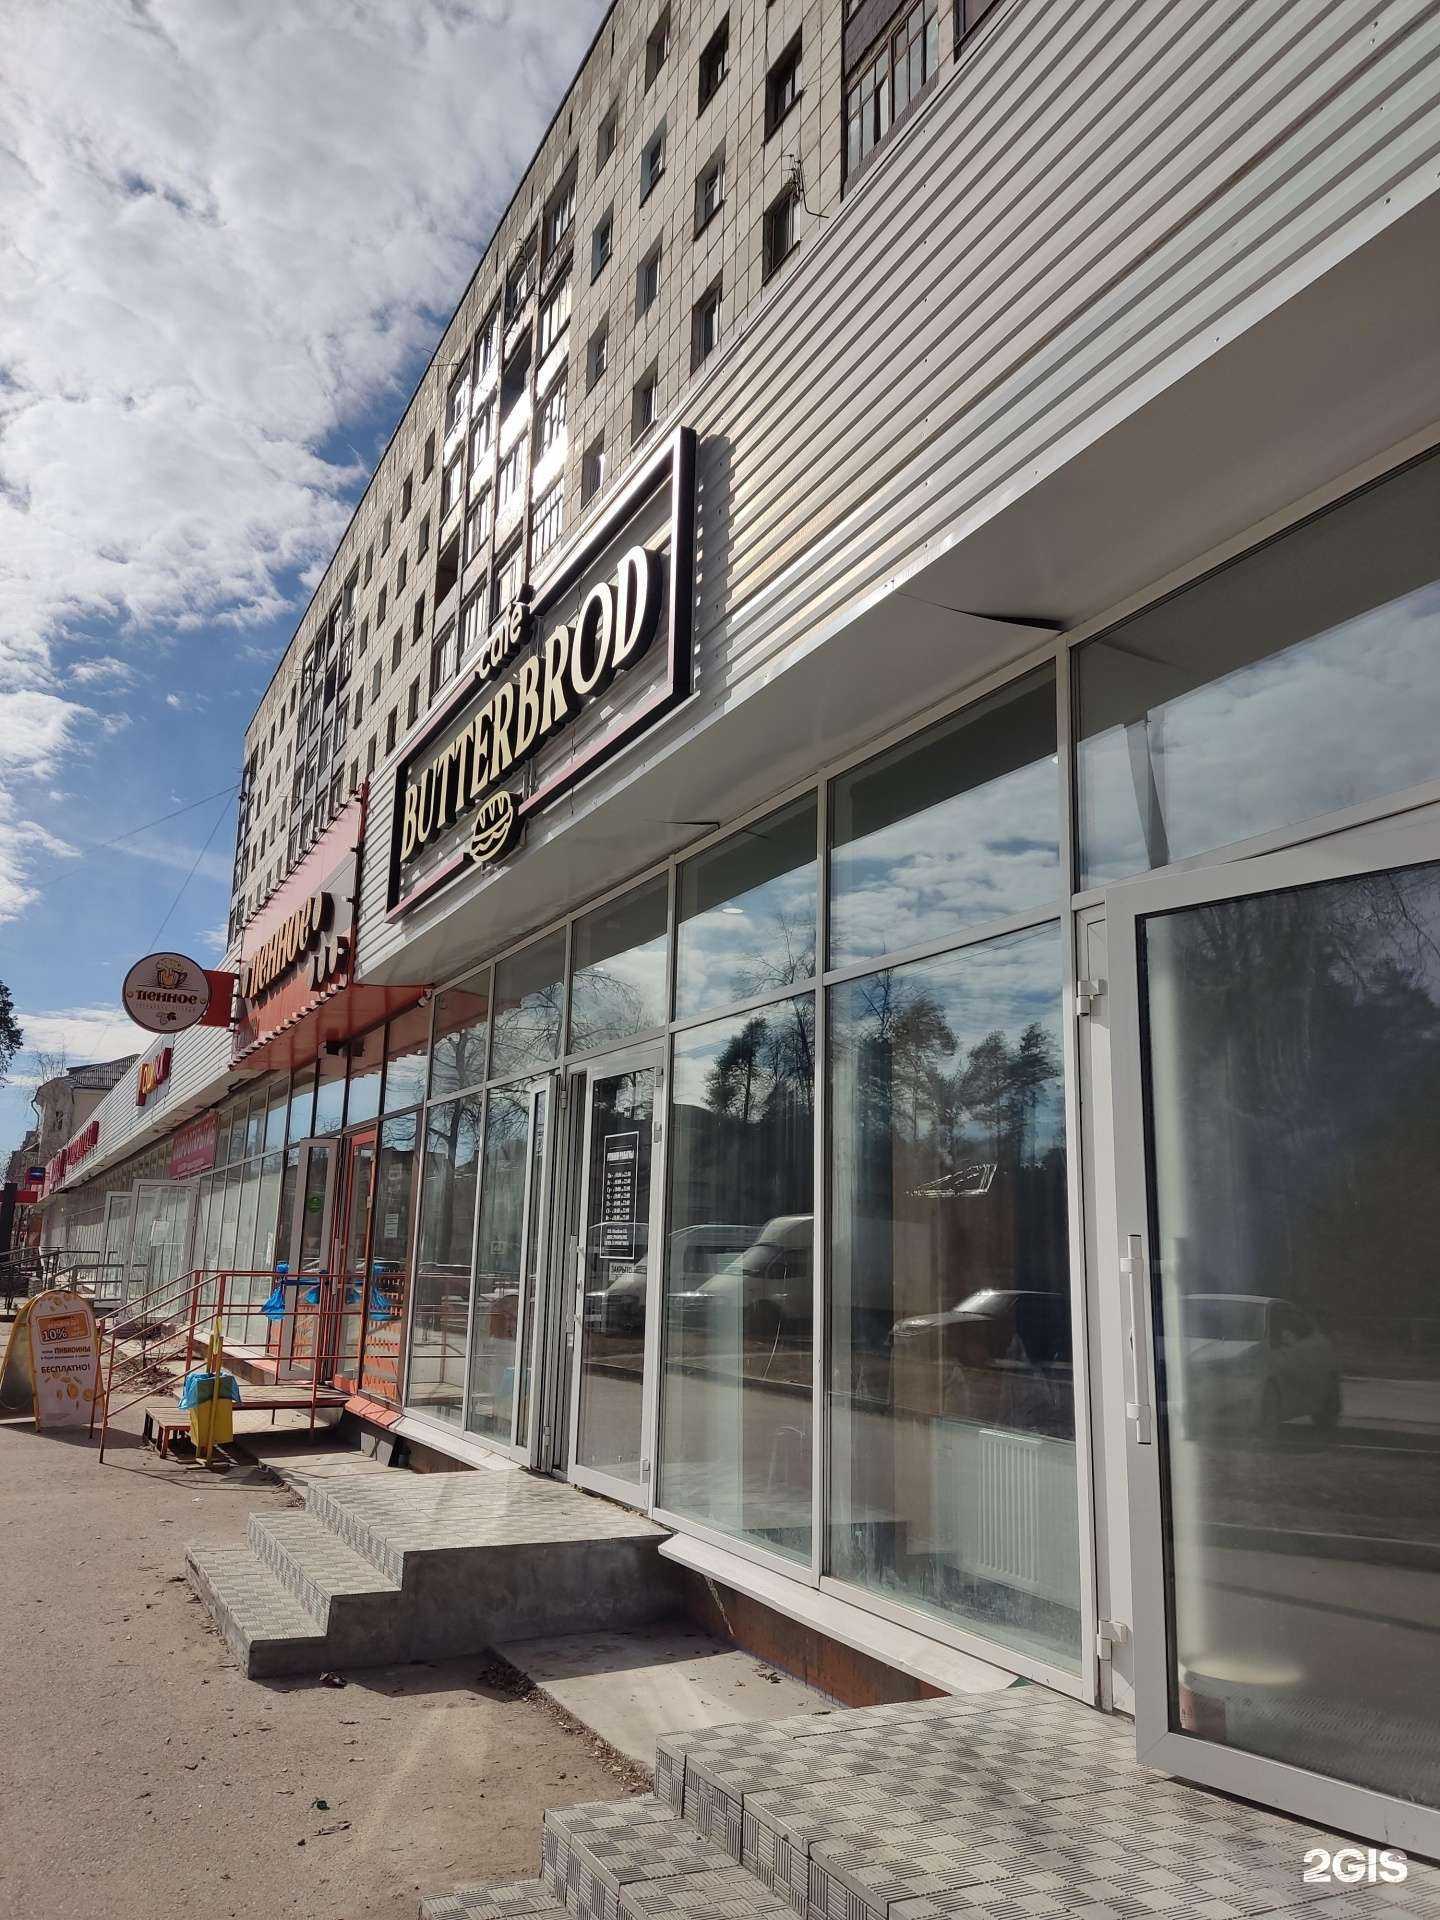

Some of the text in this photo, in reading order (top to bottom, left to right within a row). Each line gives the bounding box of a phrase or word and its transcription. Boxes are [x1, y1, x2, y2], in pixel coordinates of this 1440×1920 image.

[400, 545, 650, 863] BUTTERBROD
[41, 1327, 68, 1342] 10%
[41, 1363, 91, 1374] БЕСПЛАТНО!
